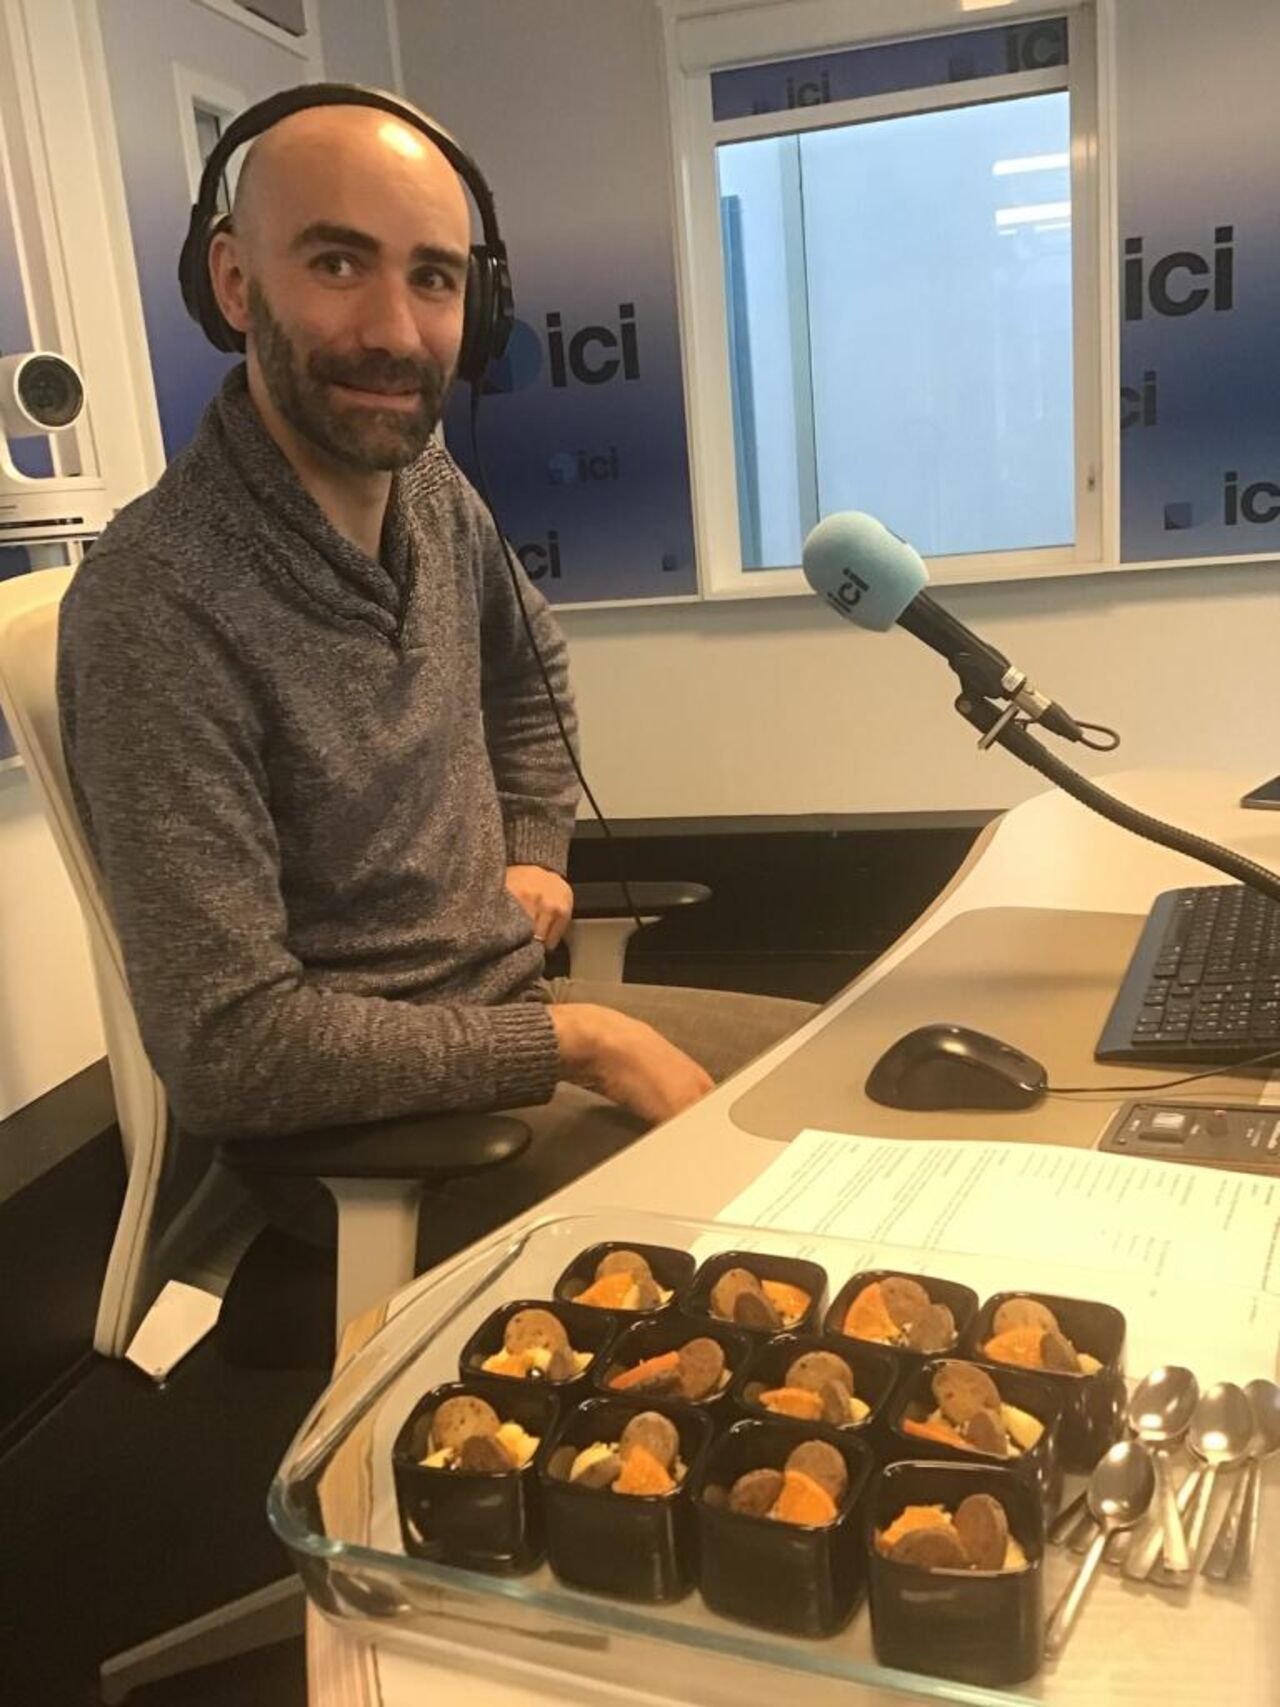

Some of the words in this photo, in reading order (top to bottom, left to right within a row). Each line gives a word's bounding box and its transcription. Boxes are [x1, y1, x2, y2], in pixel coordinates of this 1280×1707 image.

[1006, 26, 1064, 73] ic
[786, 71, 830, 109] ici
[1124, 226, 1234, 321] ici
[546, 303, 640, 388] ici
[1120, 371, 1157, 430] ci
[577, 446, 619, 483] ici
[1225, 471, 1280, 526] ic
[517, 529, 561, 581] ci
[827, 567, 870, 614] ici
